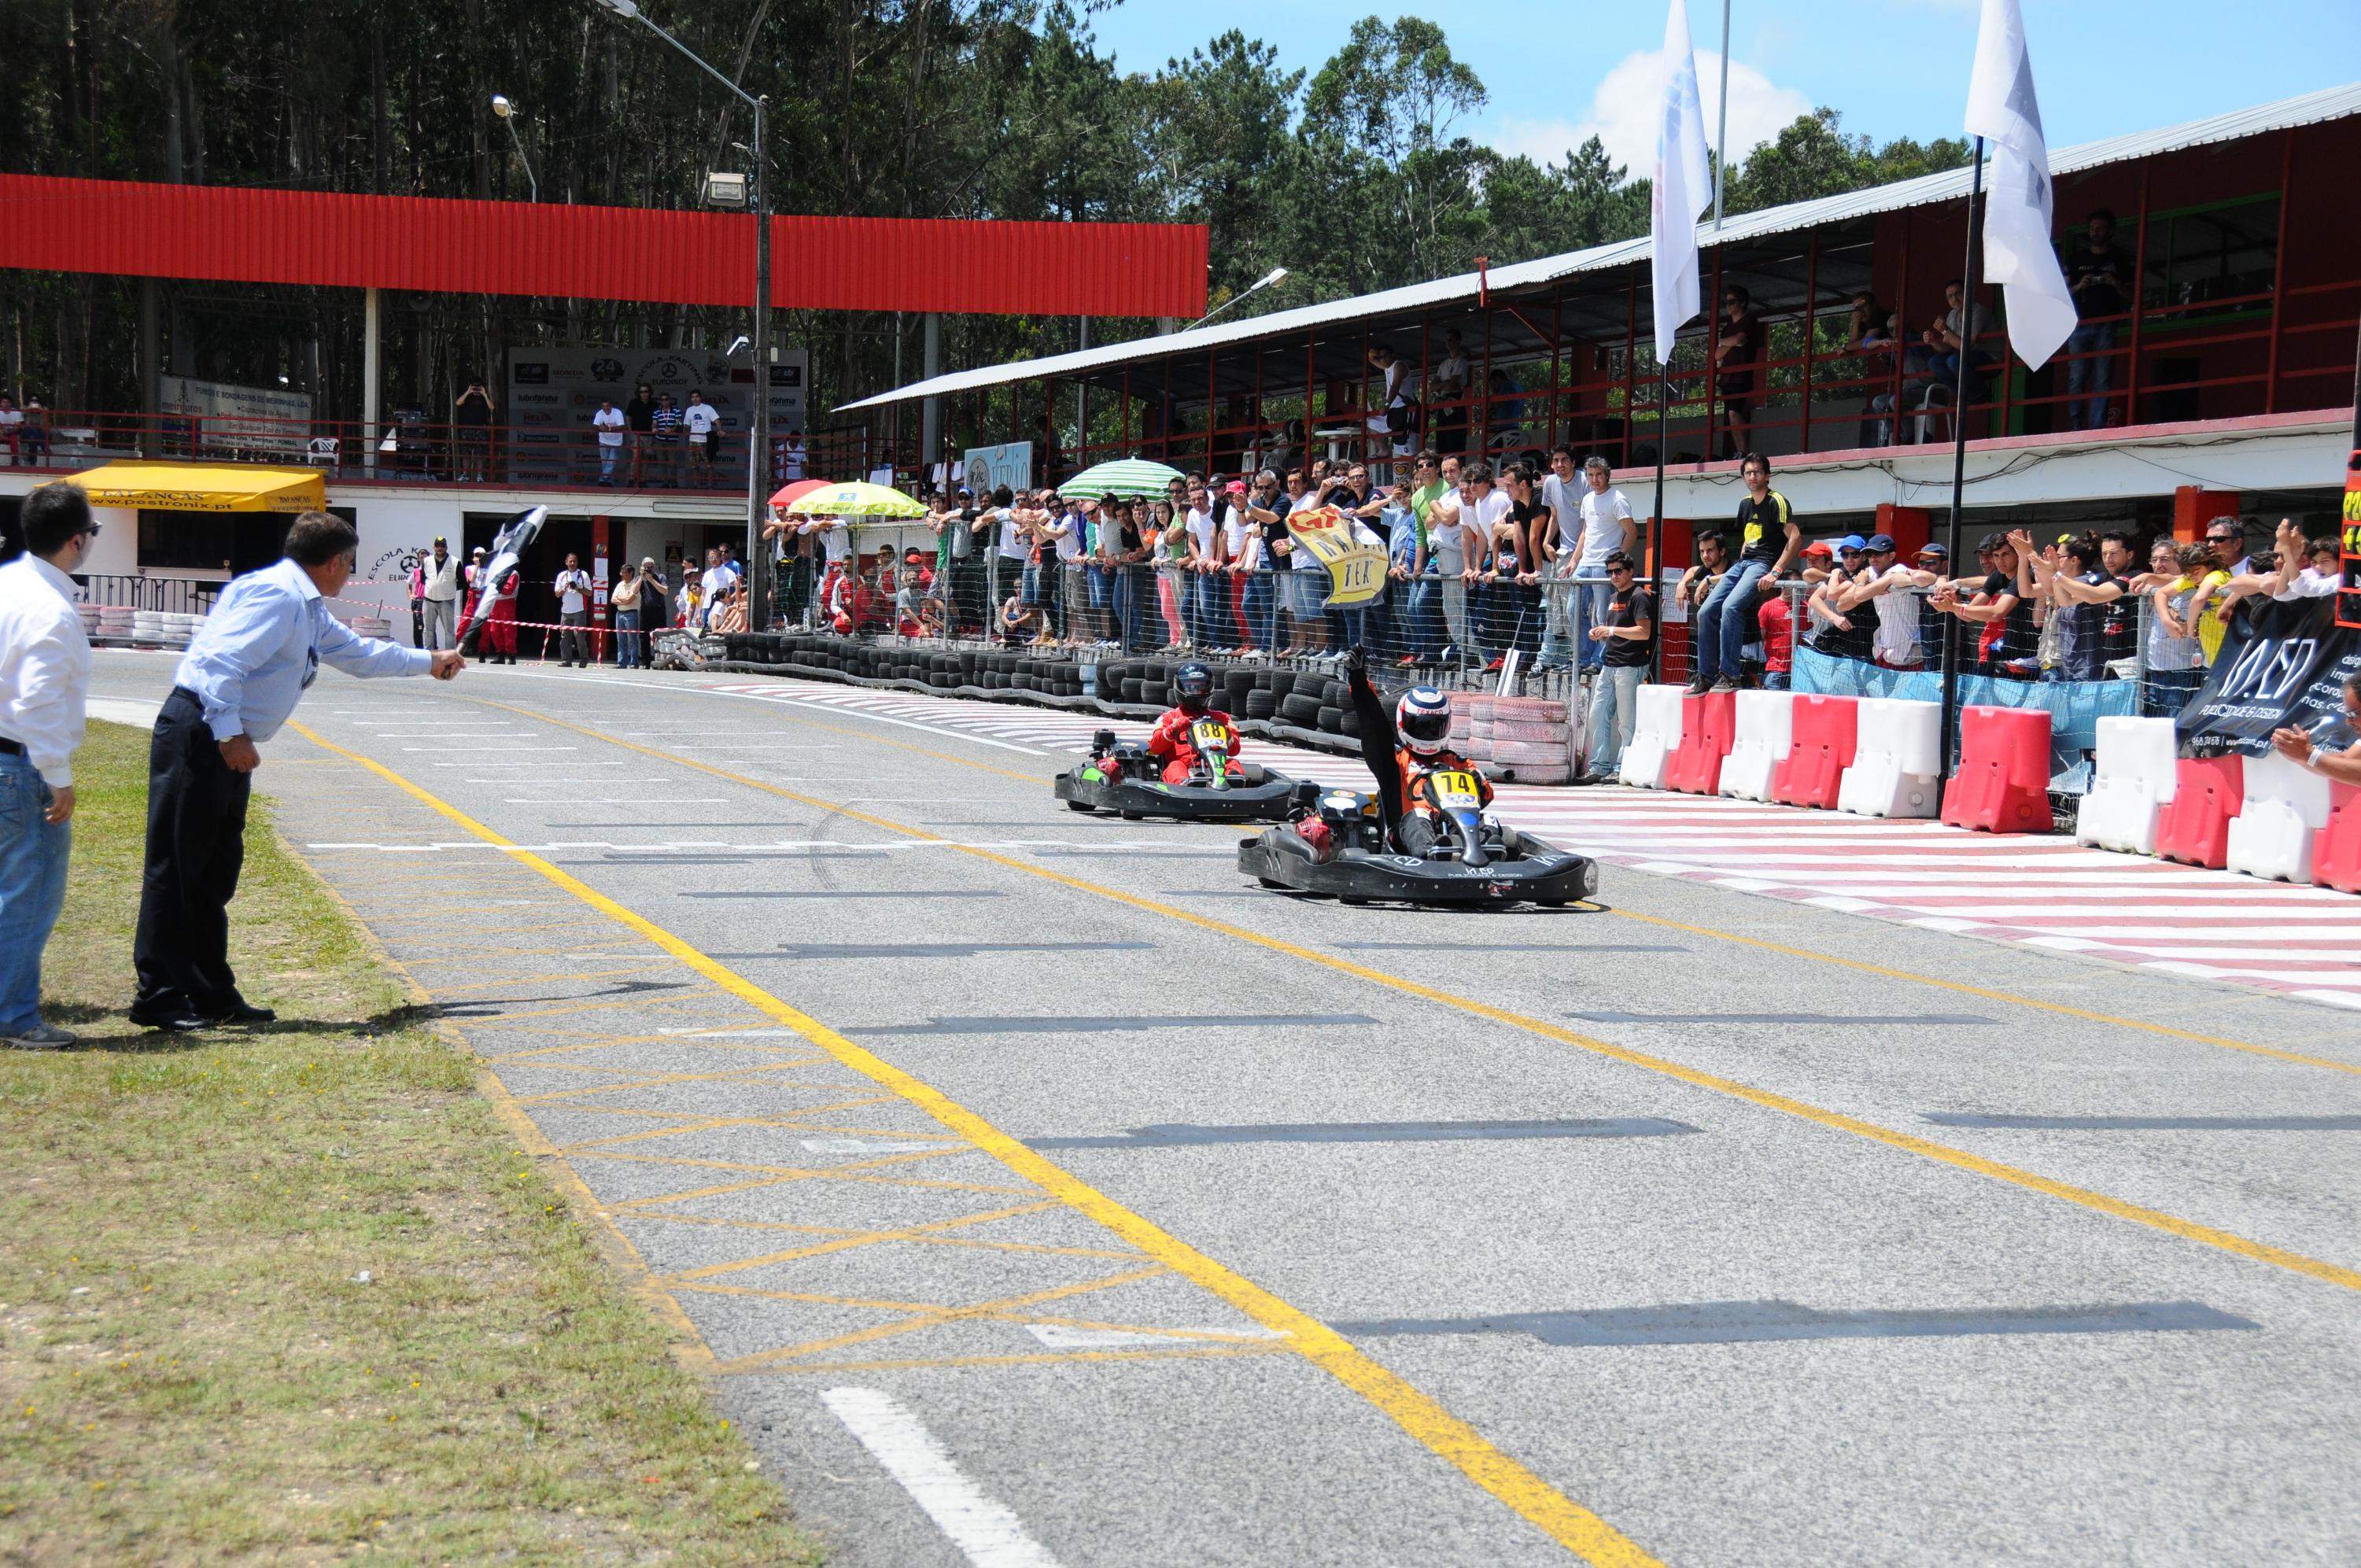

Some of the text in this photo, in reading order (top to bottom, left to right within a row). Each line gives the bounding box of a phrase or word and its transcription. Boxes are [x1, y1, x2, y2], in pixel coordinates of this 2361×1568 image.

[195, 386, 215, 397] FUROS
[221, 391, 256, 402] SONDAGENS
[87, 498, 233, 511] ww.pestronix.pt
[367, 548, 404, 581] ESCOLA
[1199, 724, 1221, 738] 88
[1441, 774, 1470, 793] 74
